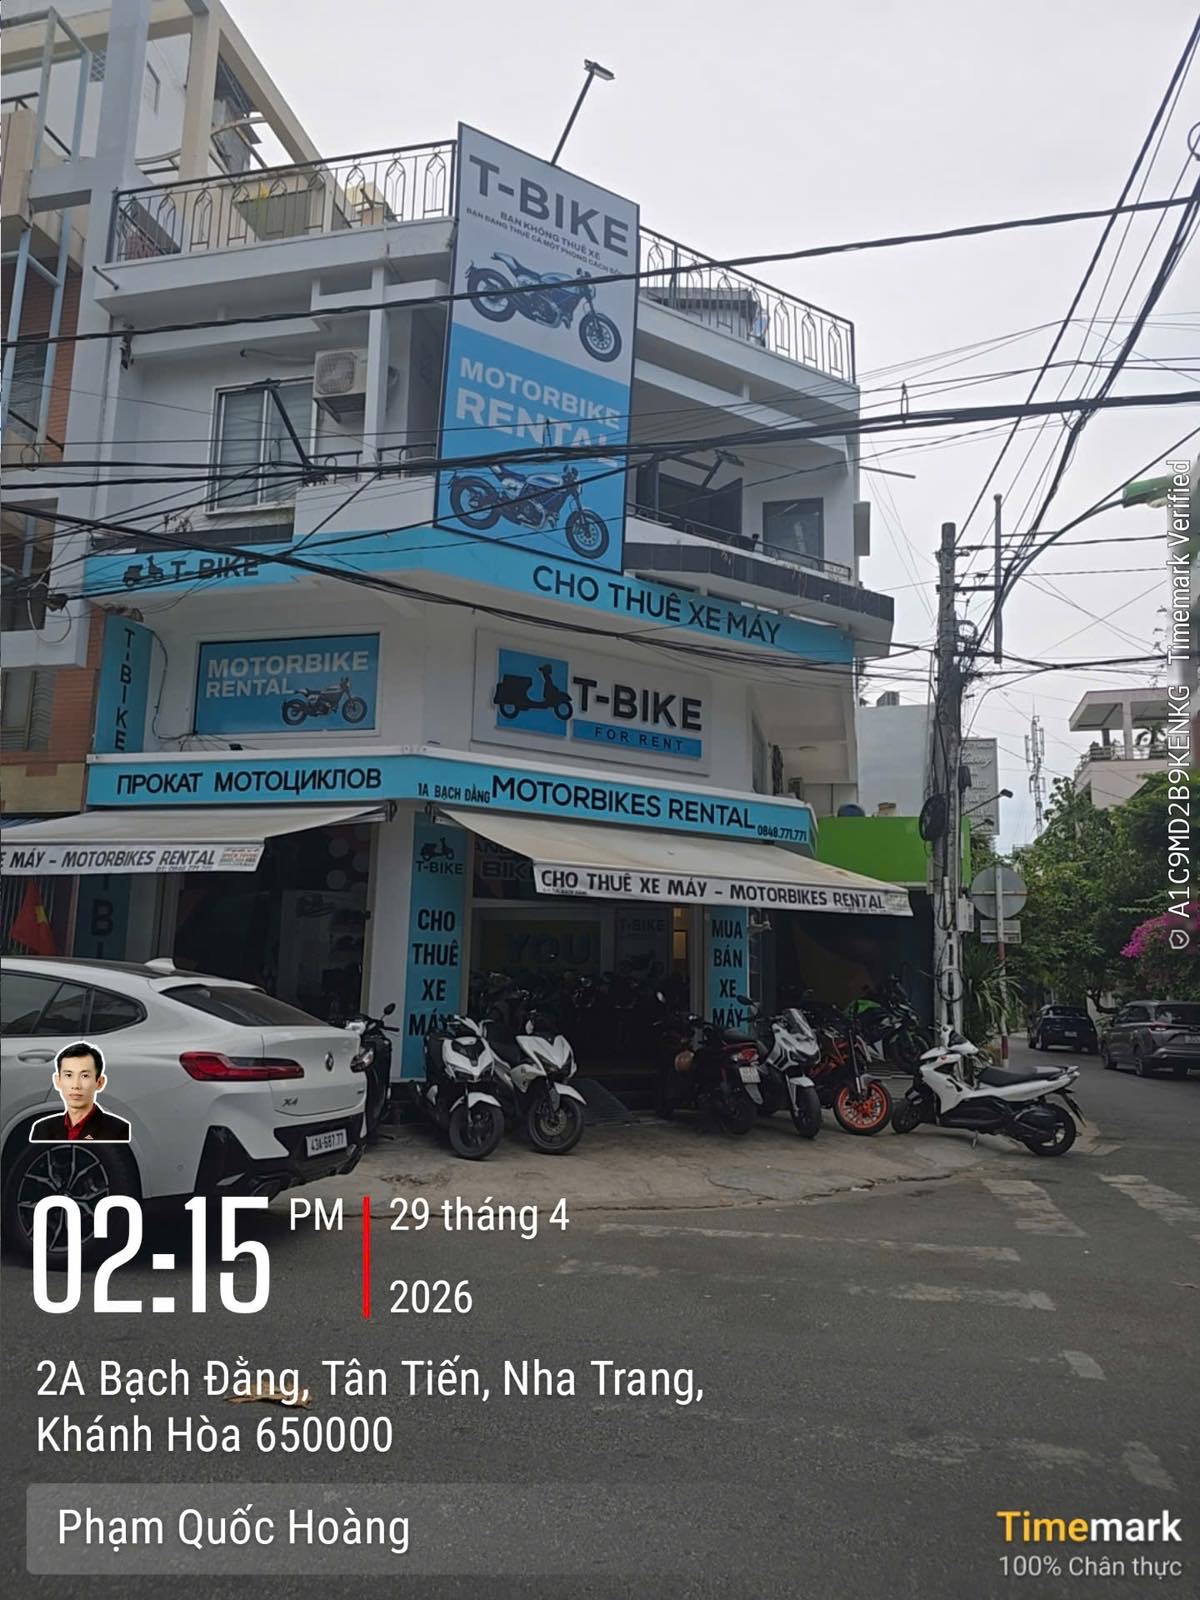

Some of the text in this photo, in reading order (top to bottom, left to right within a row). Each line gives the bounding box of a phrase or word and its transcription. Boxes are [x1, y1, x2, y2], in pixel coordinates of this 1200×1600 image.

[469, 154, 629, 257] T-BIKE
[588, 249, 600, 260] XE
[460, 356, 621, 430] MOTORBIKE
[532, 565, 782, 645] CHO THUÊ XE MÁY
[207, 650, 370, 679] MOTORBIKE
[205, 677, 296, 699] RENTAL
[572, 676, 703, 731] T-BIKE
[594, 726, 683, 751] FOR RENT
[117, 767, 382, 796] ПРОКАТ МОТОЦИКЛОВ
[417, 782, 429, 797] 1A
[492, 774, 755, 830] MOTORBIKES RENTAL
[757, 824, 807, 842] 0848.771.771
[9, 847, 46, 868] MÁY
[61, 850, 154, 868] MOTORBIKES
[159, 850, 215, 866] RENTAL
[415, 860, 464, 875] T-BIKE
[541, 869, 578, 888] CHO
[587, 873, 632, 893] THUÊ
[639, 876, 660, 895] XE
[667, 877, 708, 897] MÁY
[730, 884, 827, 906] MOTORBIKES
[833, 892, 885, 909] RENTAL
[417, 908, 456, 932] CHO
[711, 919, 743, 939] MUA
[412, 940, 459, 967] THUÊ
[713, 945, 743, 968] BÁN
[422, 979, 446, 1001] XE
[719, 979, 736, 998] XE
[409, 1008, 454, 1036] MÁY
[712, 1004, 743, 1028] MÁY
